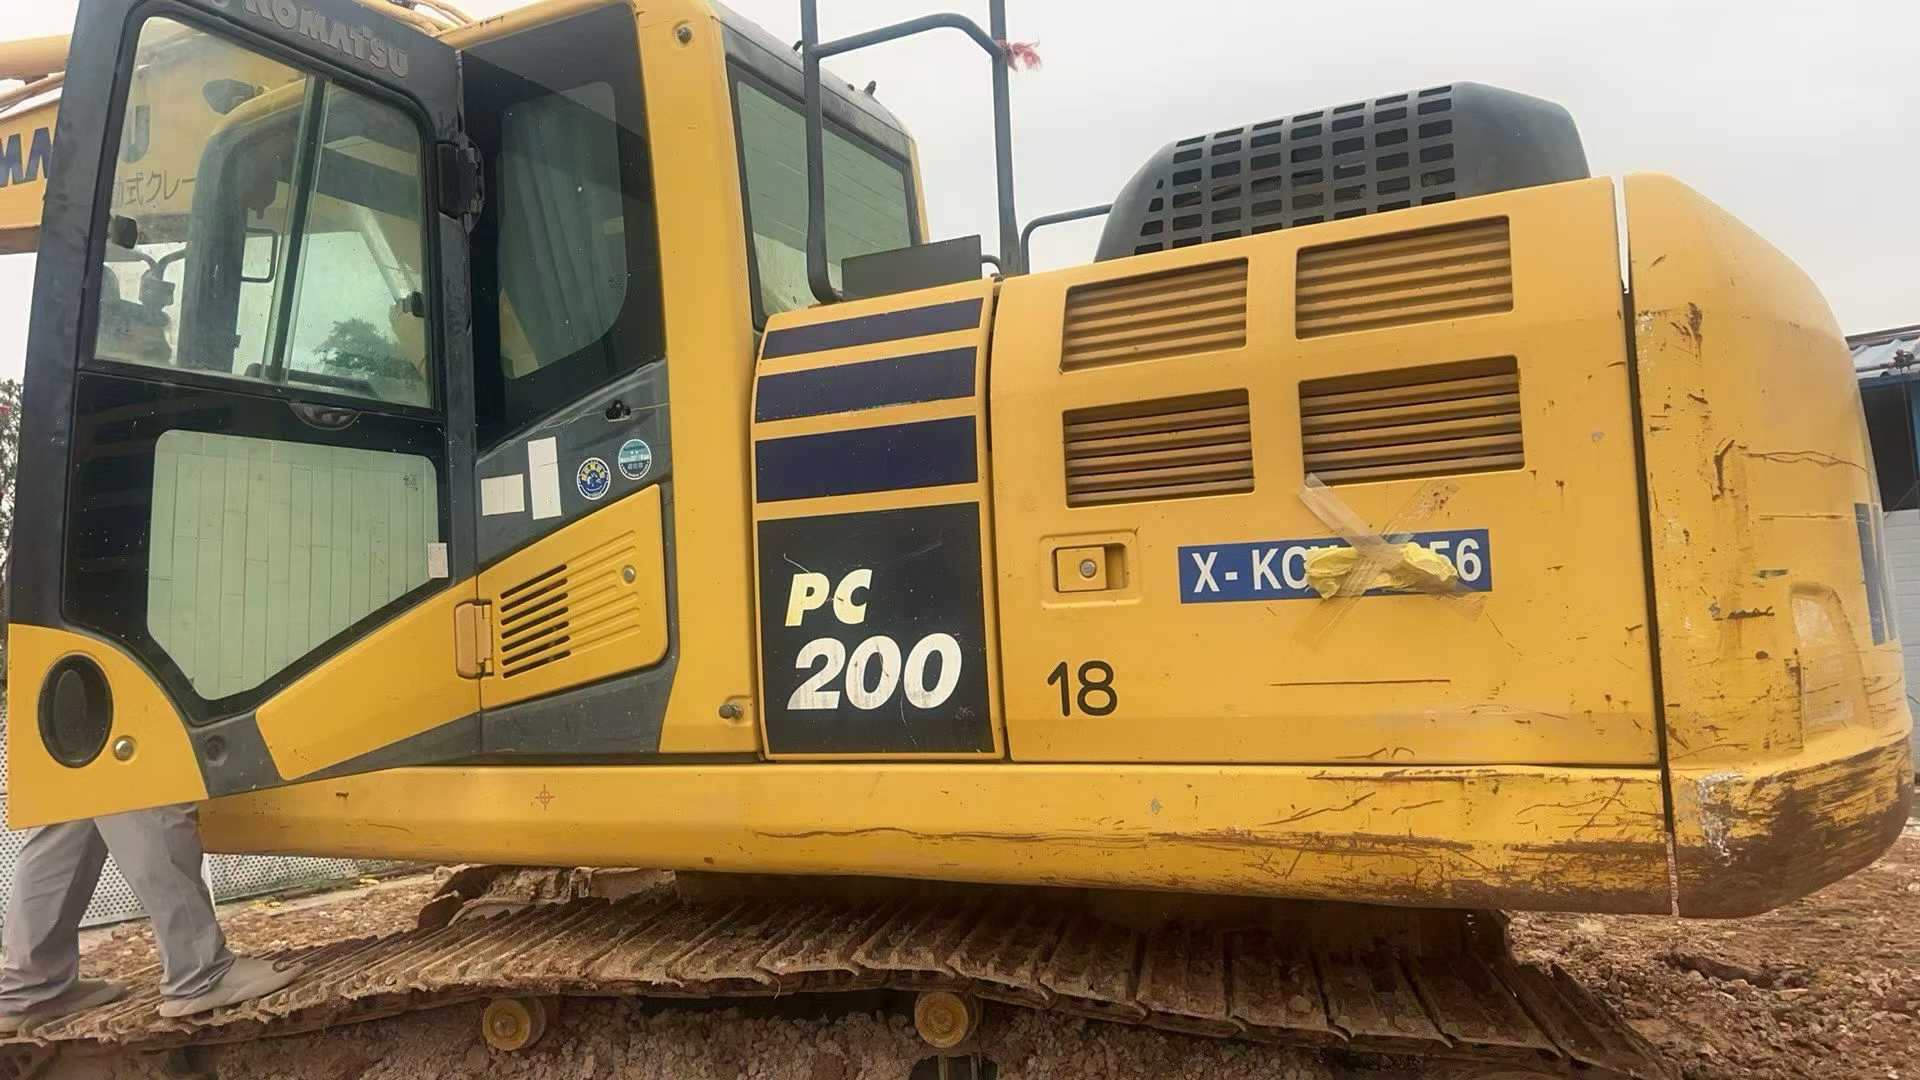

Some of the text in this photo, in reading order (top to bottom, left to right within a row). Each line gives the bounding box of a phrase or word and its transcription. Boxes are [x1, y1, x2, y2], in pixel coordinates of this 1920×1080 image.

[785, 568, 873, 627] PC
[787, 632, 962, 710] 200
[1047, 660, 1118, 717] 18
